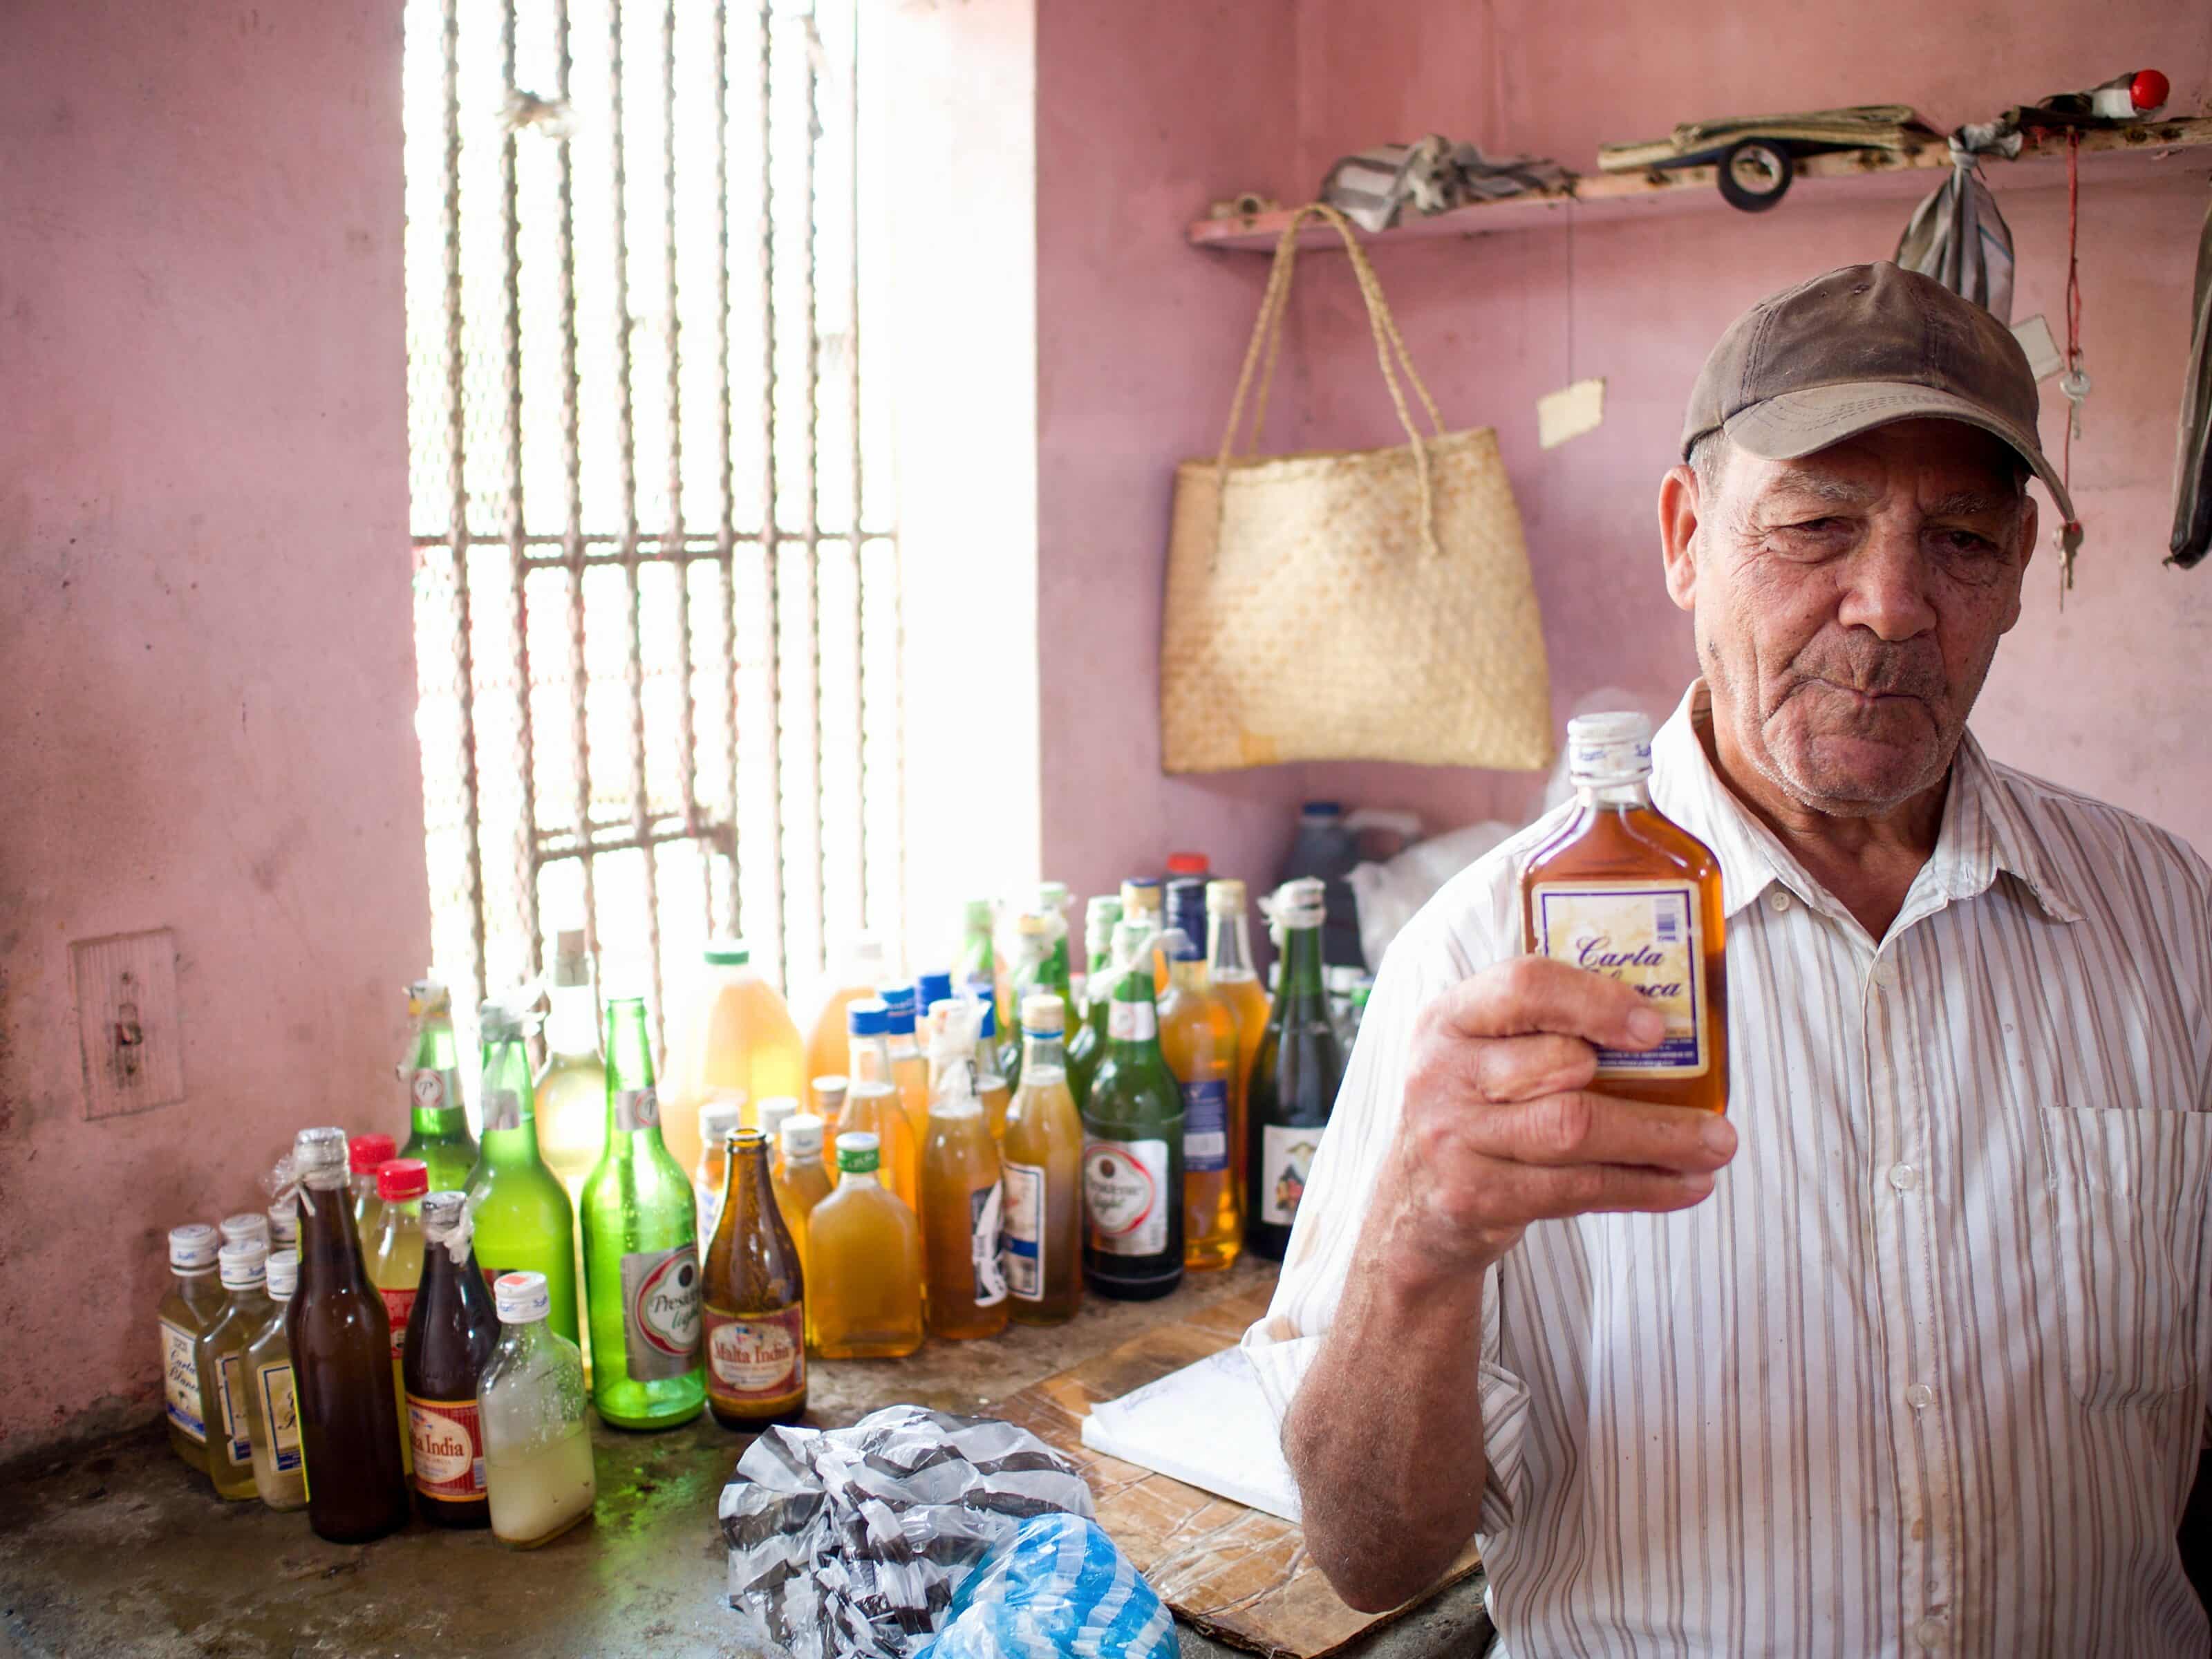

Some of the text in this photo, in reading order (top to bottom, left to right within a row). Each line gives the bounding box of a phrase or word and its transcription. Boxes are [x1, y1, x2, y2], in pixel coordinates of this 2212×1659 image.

[1576, 935, 1665, 967] Carta
[713, 1339, 790, 1364] Malta India
[426, 1434, 465, 1457] India
